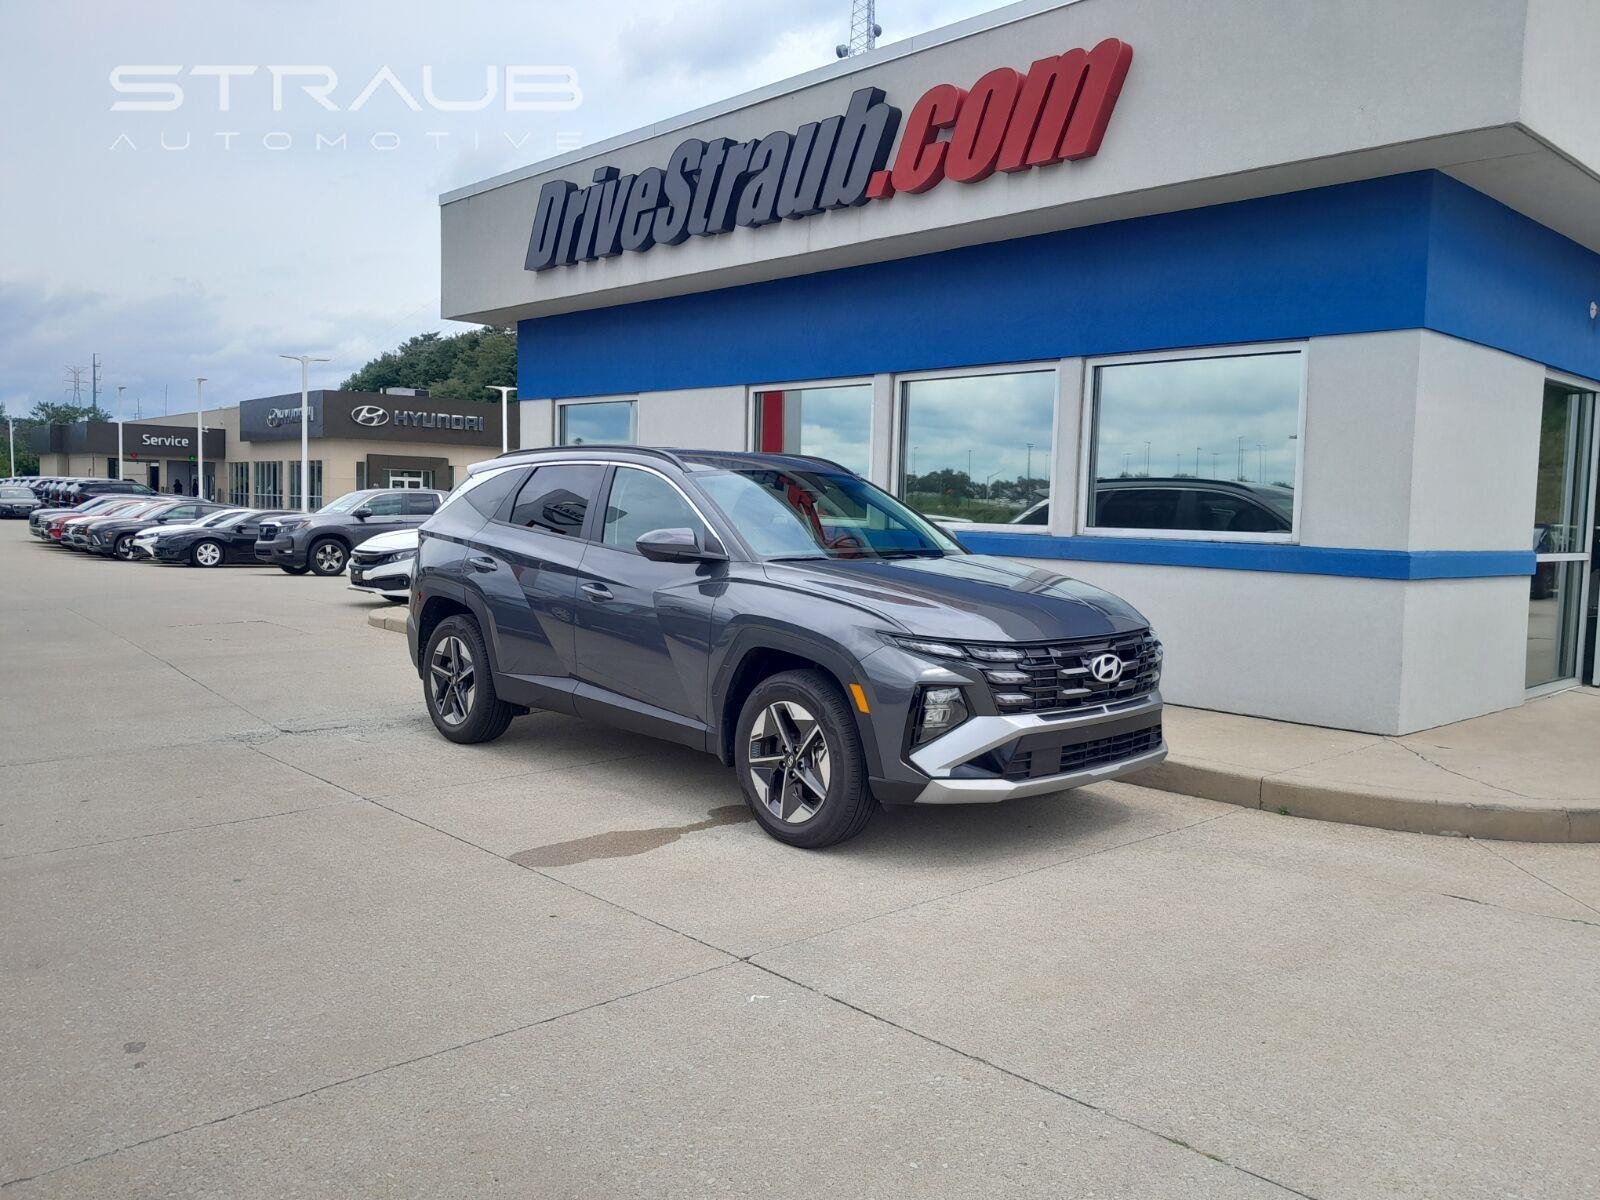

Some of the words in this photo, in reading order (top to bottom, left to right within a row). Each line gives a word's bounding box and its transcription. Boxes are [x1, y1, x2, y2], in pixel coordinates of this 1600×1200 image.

[525, 38, 1133, 272] DriveStraub.com
[394, 409, 484, 432] HYUNDAI
[142, 433, 189, 447] Service
